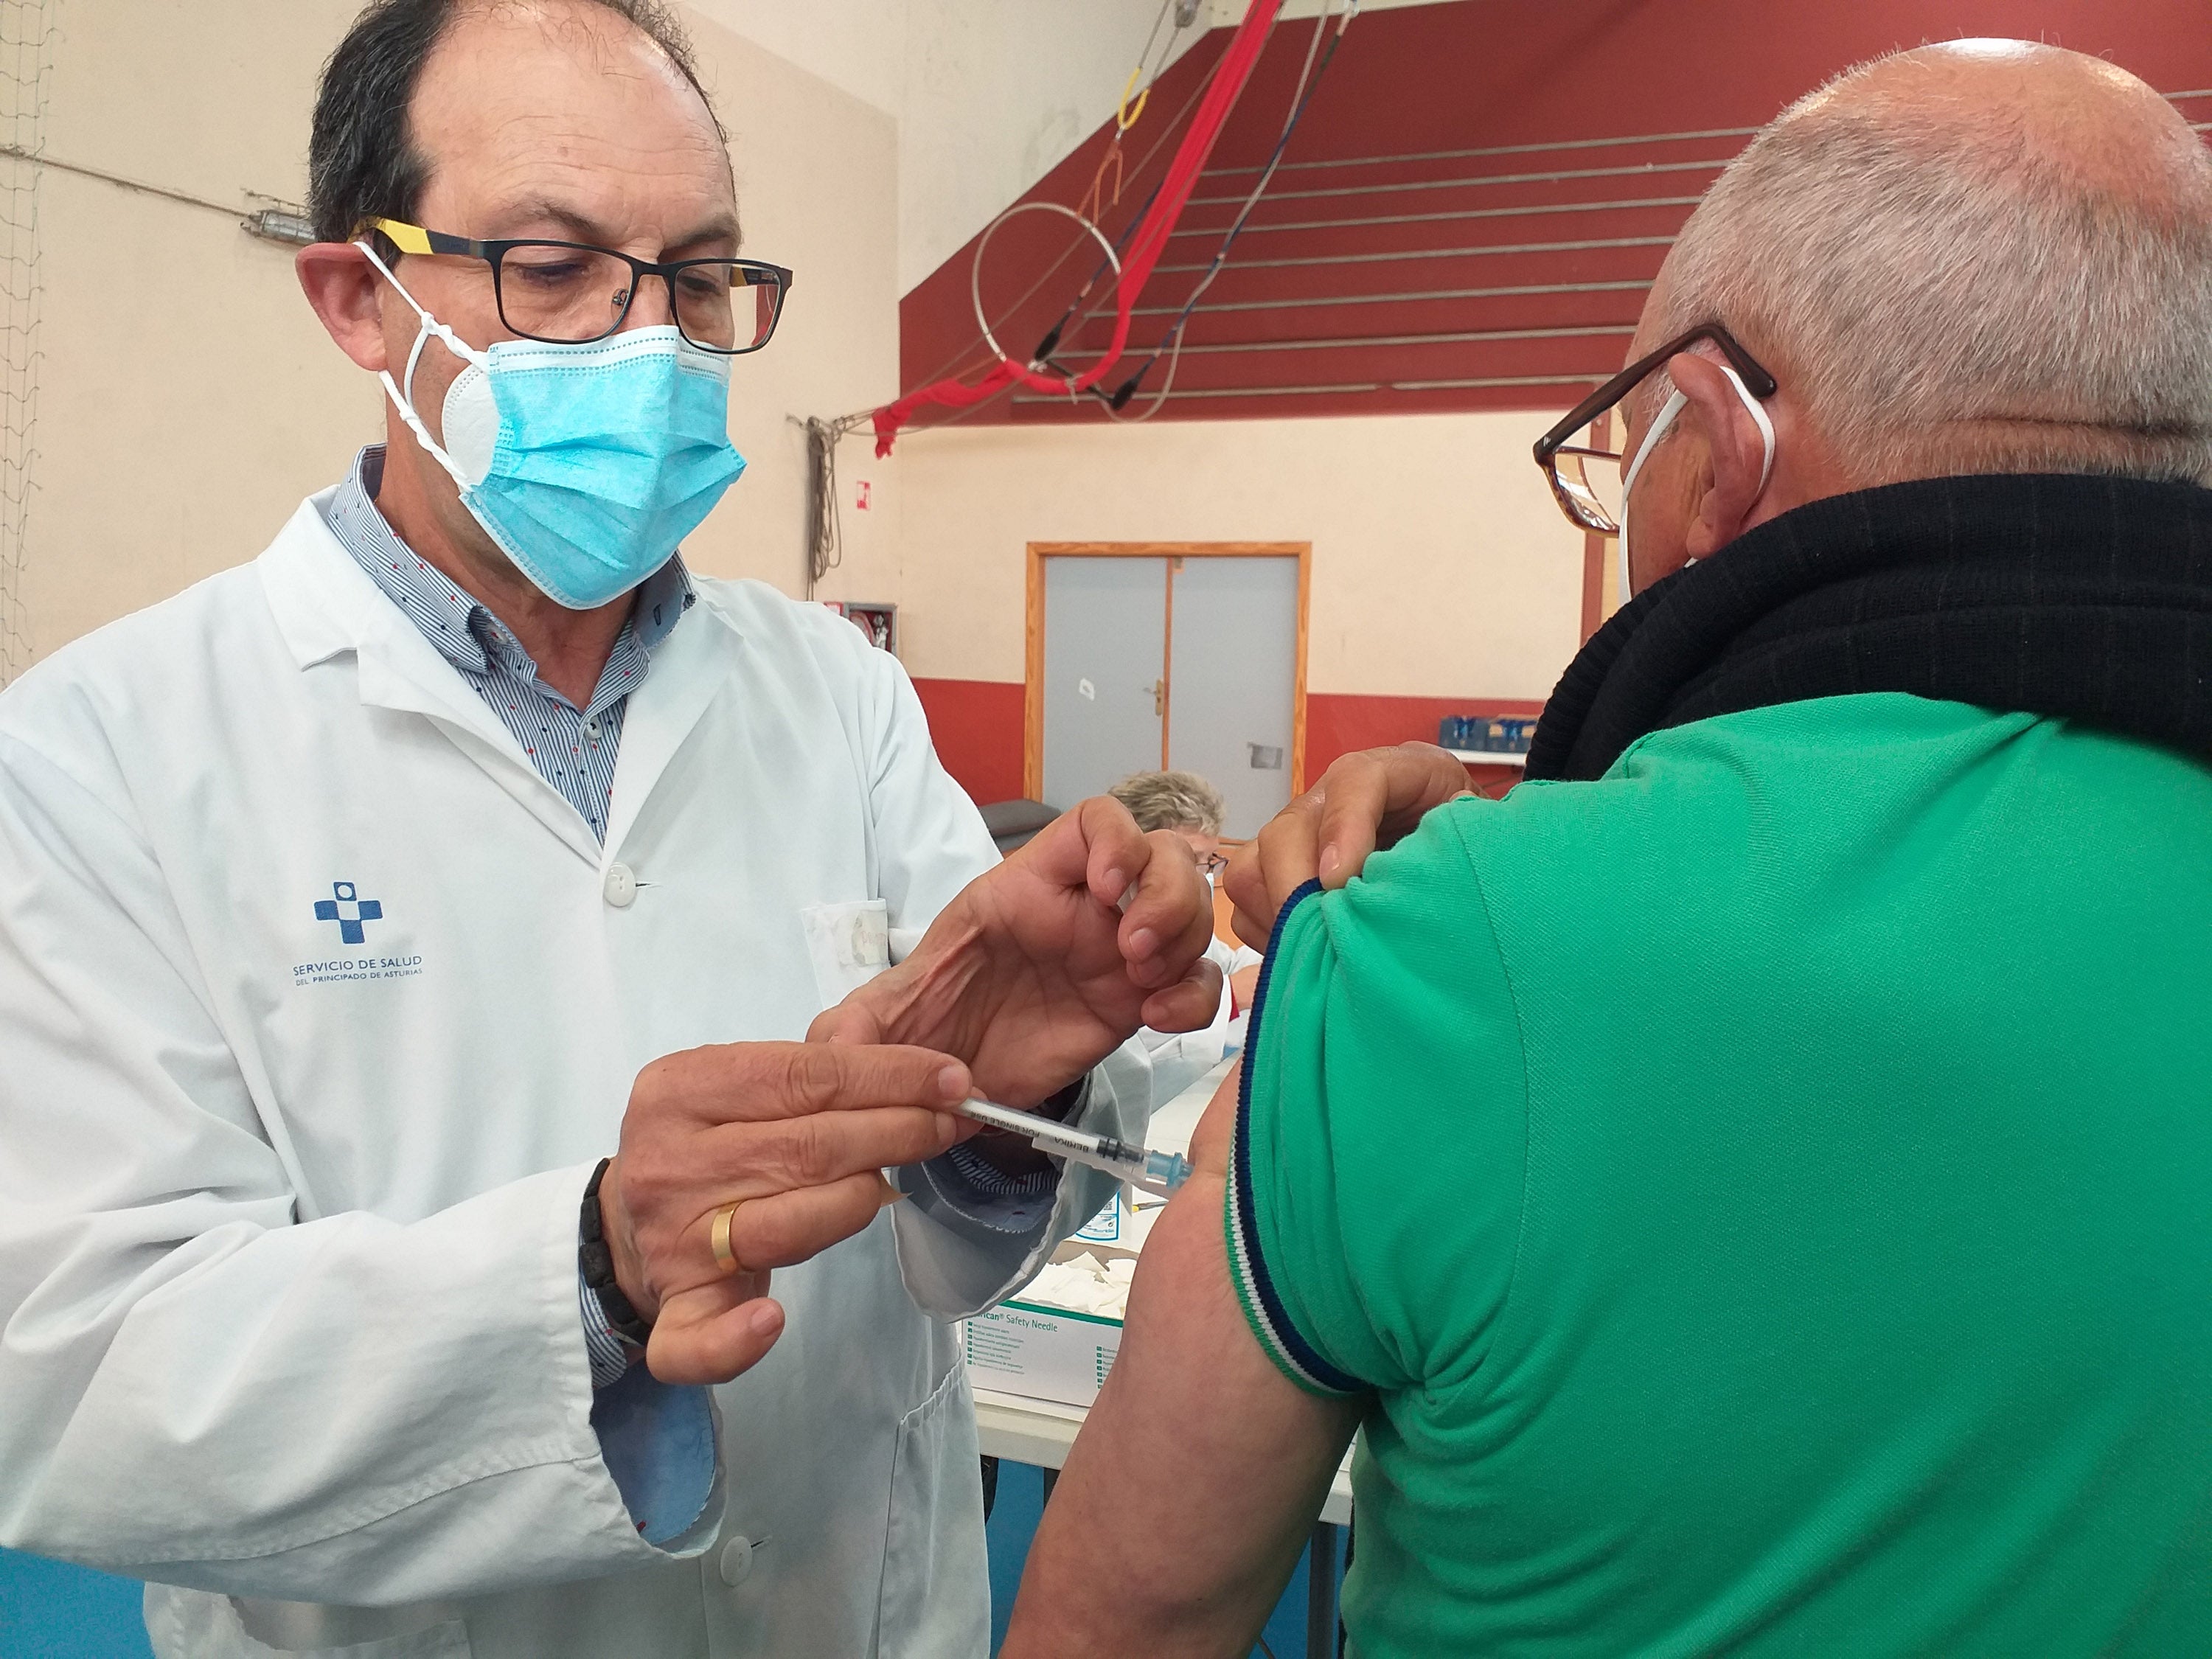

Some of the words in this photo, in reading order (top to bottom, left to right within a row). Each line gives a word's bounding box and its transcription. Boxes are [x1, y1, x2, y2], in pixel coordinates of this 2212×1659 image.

[293, 961, 354, 976] SERVICIO
[358, 959, 377, 970] DE
[380, 956, 422, 968] SALUD
[296, 978, 309, 987] DEL
[313, 973, 367, 983] PRINCIPADO
[383, 967, 422, 978] ASTURIAS
[990, 1117, 1020, 1132] SINGLE
[1006, 1314, 1030, 1328] Safety
[1032, 1319, 1058, 1332] Needle
